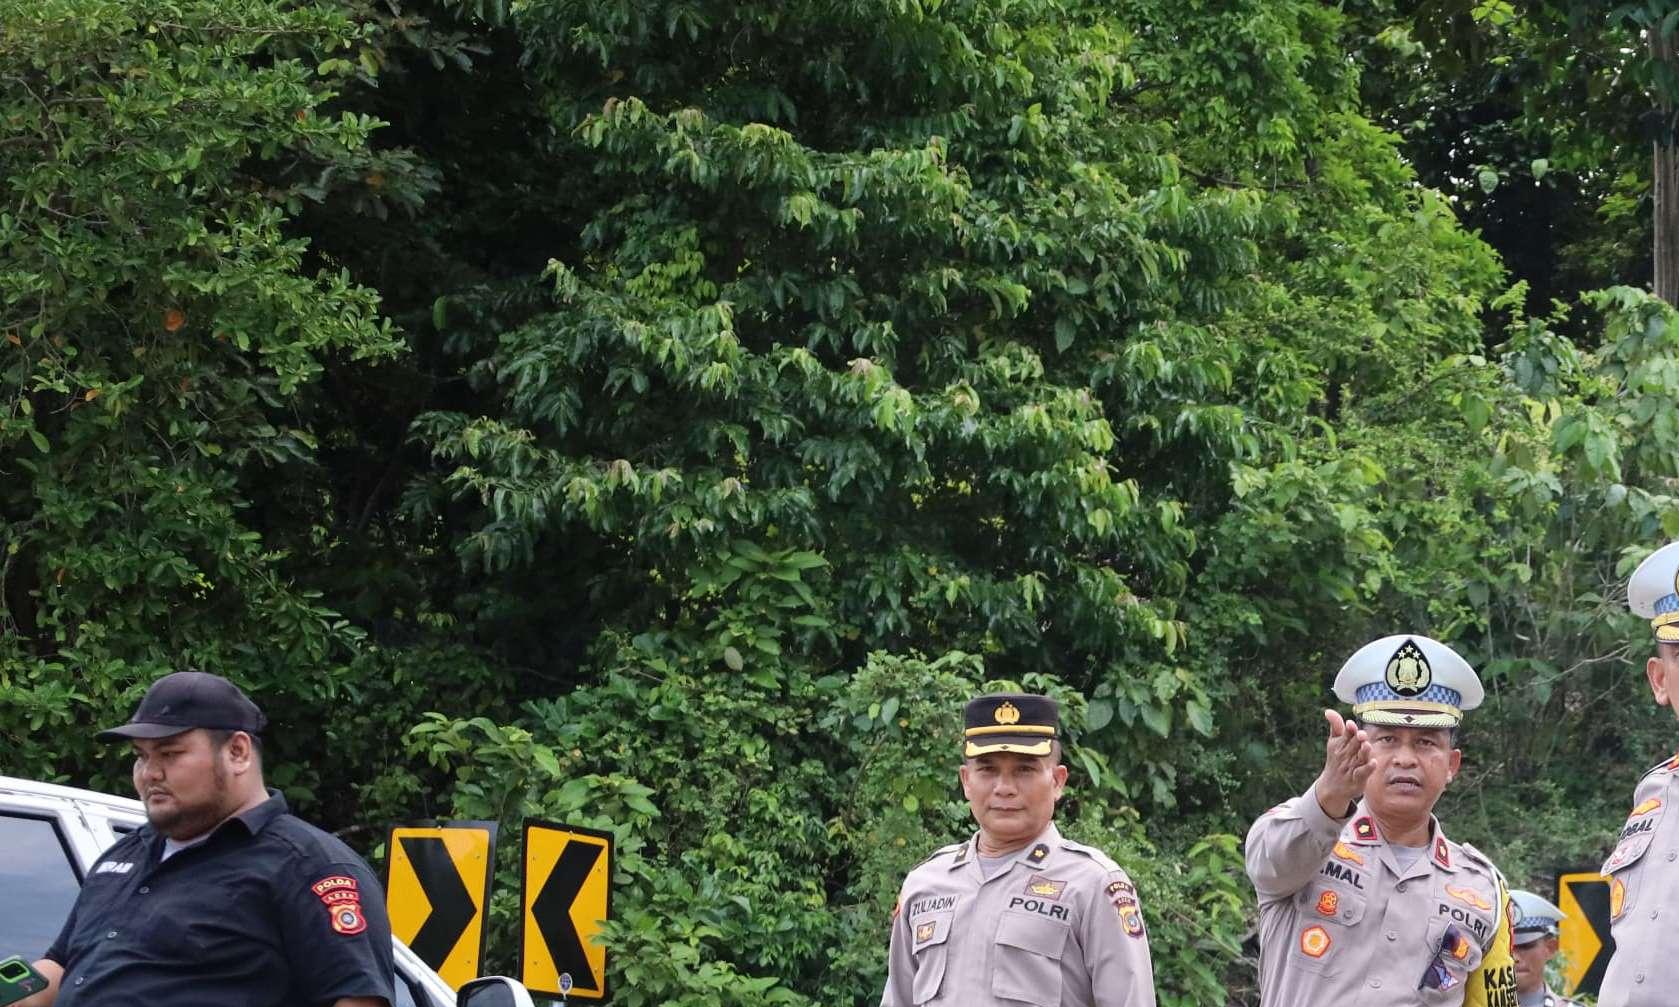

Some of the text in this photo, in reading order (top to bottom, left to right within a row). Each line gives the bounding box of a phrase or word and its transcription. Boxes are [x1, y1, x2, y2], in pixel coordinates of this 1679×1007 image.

[316, 879, 352, 892] POLDA
[1009, 897, 1070, 921] POLRI
[1439, 903, 1487, 940] POLRI
